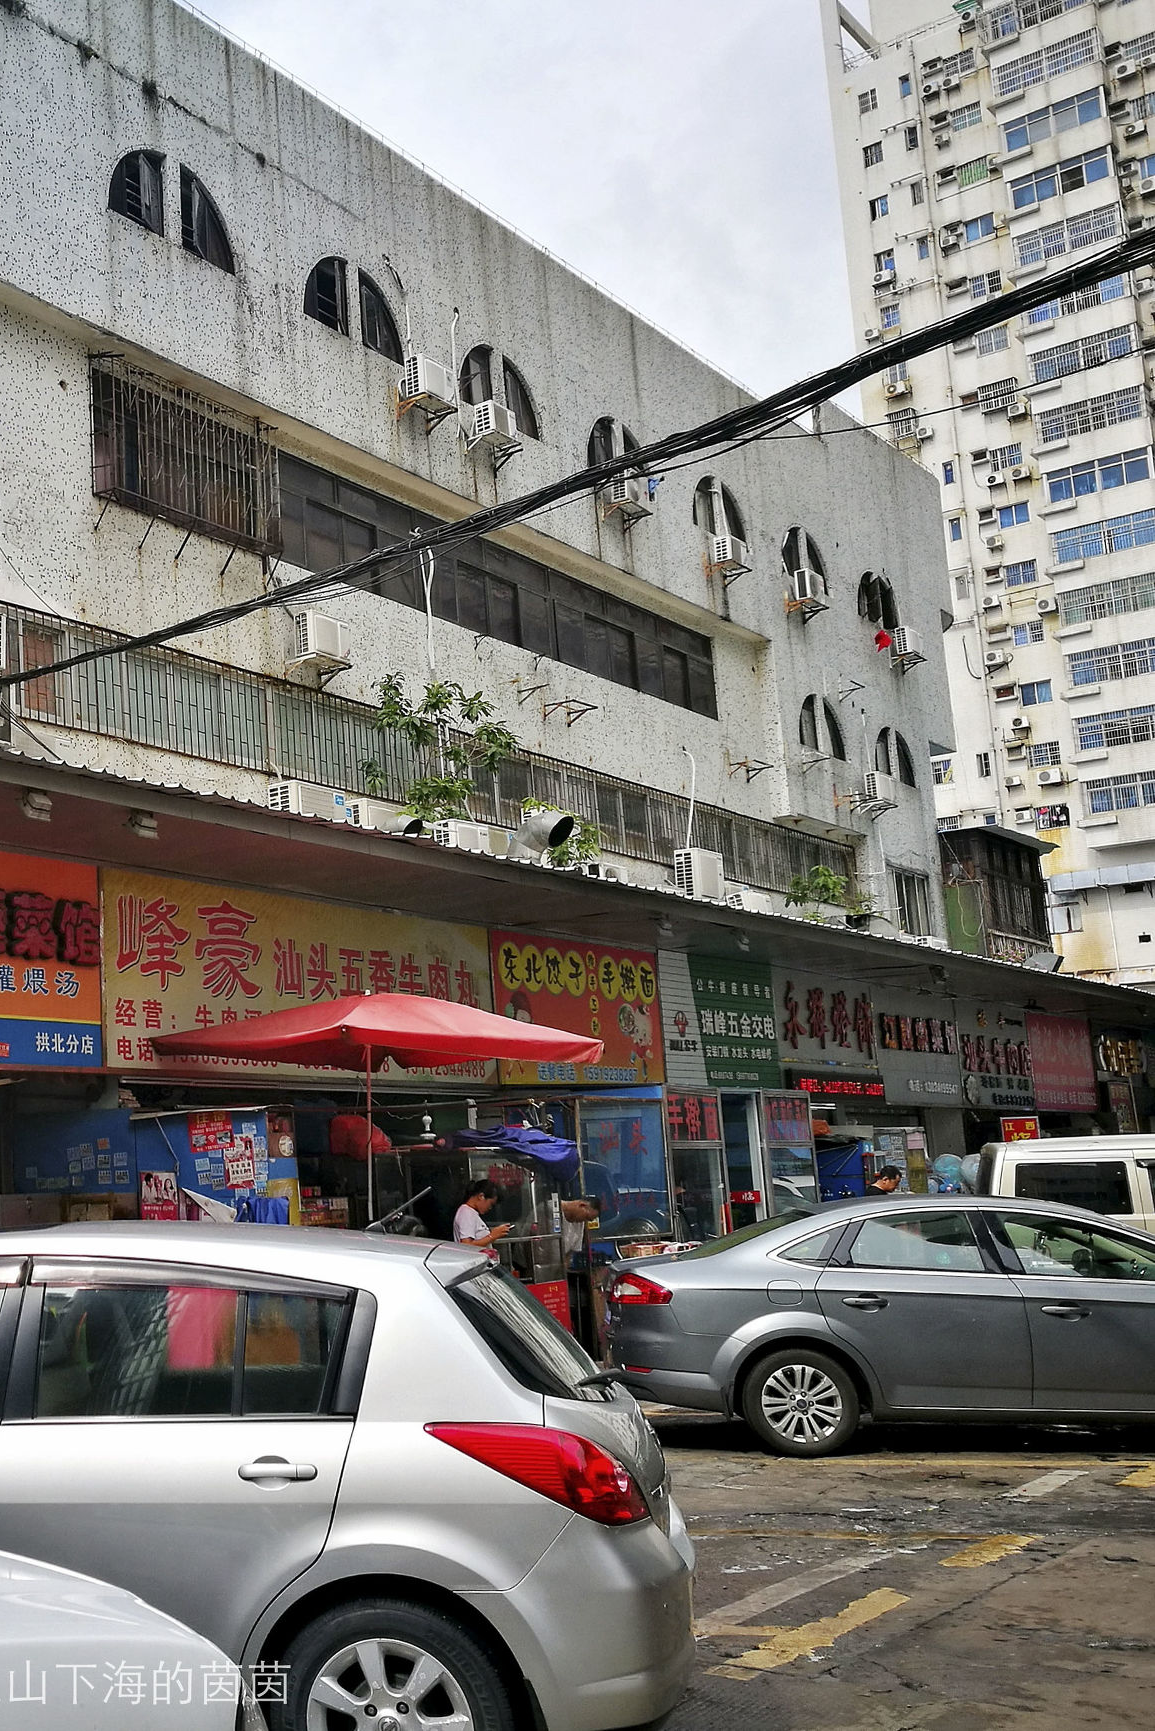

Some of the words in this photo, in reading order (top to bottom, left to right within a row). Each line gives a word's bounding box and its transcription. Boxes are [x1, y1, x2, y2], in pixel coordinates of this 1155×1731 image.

[115, 894, 263, 999] 峰豪
[502, 947, 583, 992] 东北饺子
[35, 1031, 94, 1055] 拱北分店
